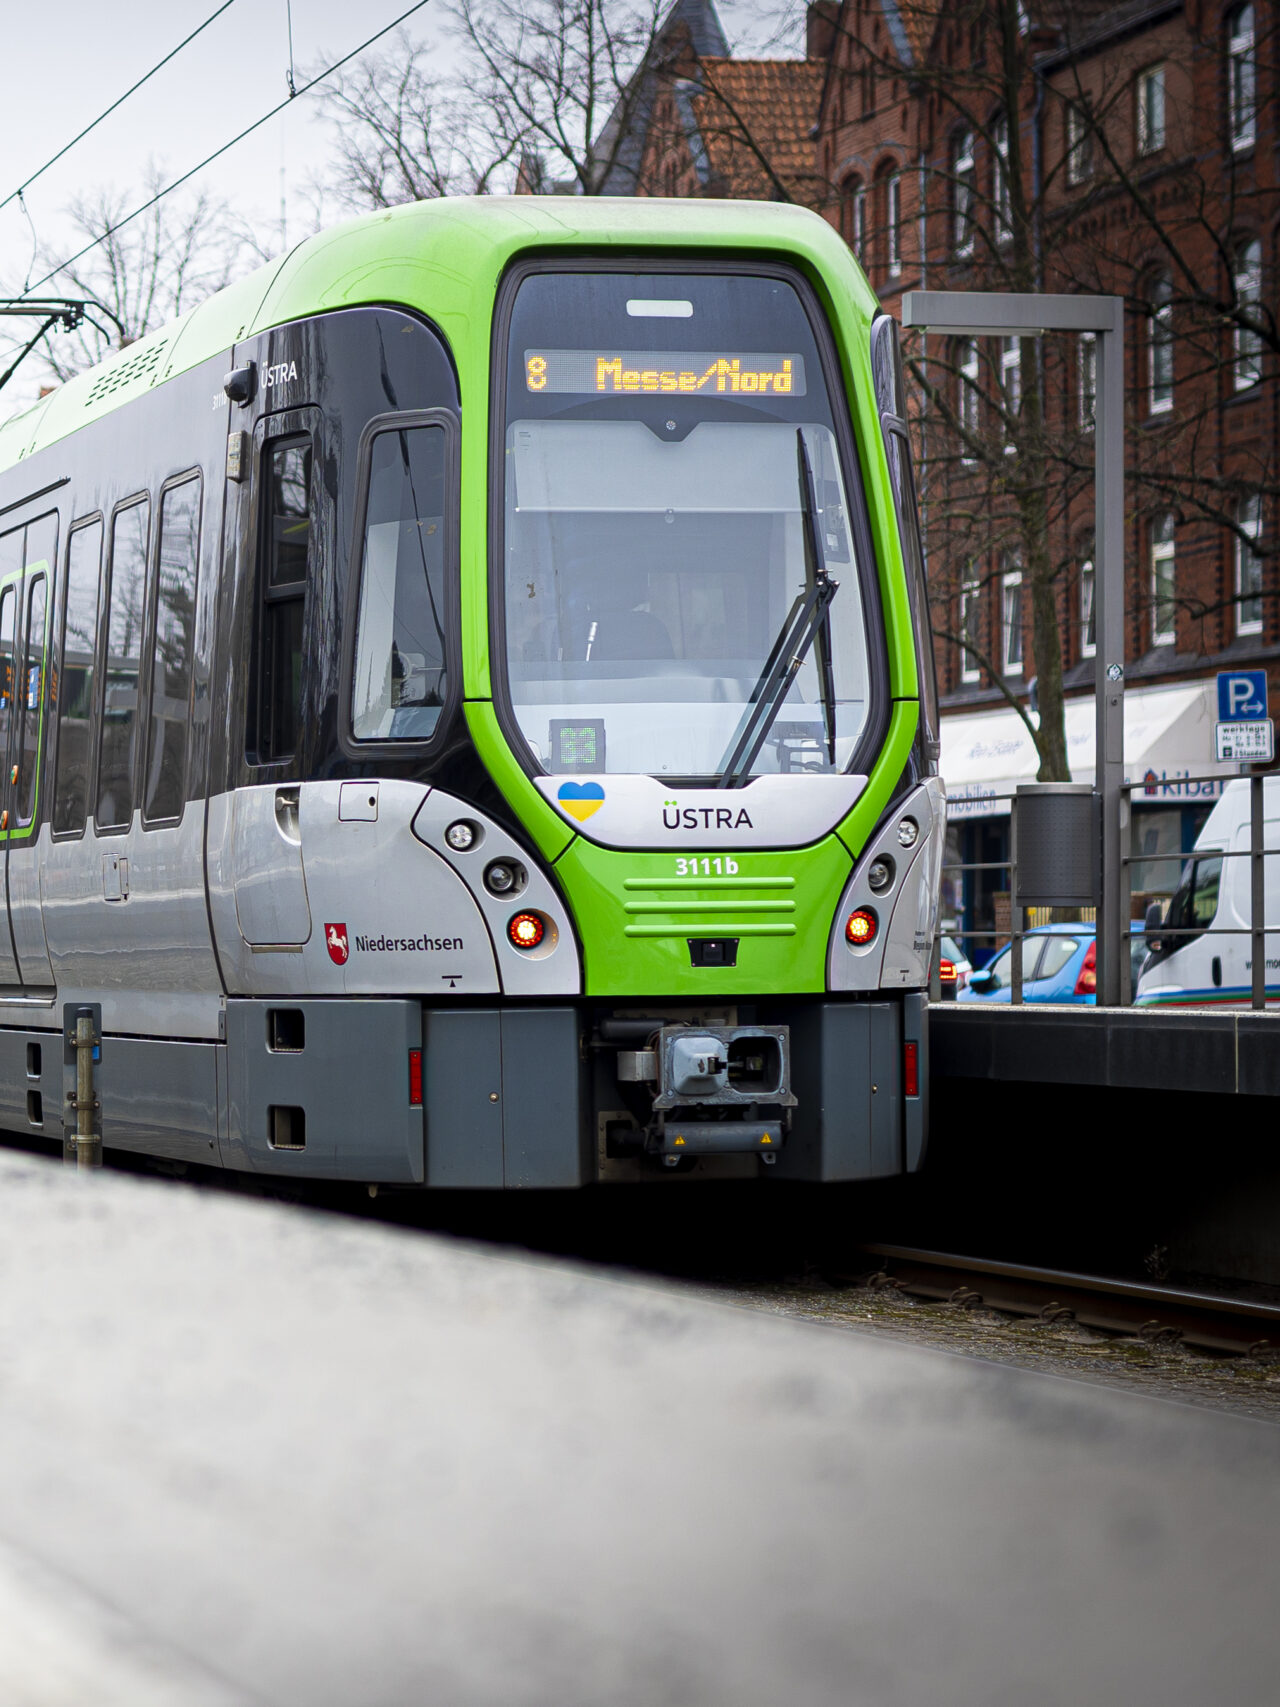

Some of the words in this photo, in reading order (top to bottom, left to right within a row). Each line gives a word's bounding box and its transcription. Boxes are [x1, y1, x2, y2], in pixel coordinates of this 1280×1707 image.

[260, 361, 298, 389] ÜSTRA
[527, 357, 547, 390] 8
[596, 357, 793, 392] Messe/Nord
[1229, 678, 1254, 716] P
[947, 784, 997, 813] mobilien
[662, 800, 754, 830] ÜSTRA
[675, 856, 739, 876] 3111b
[355, 933, 464, 952] Niedersachsen
